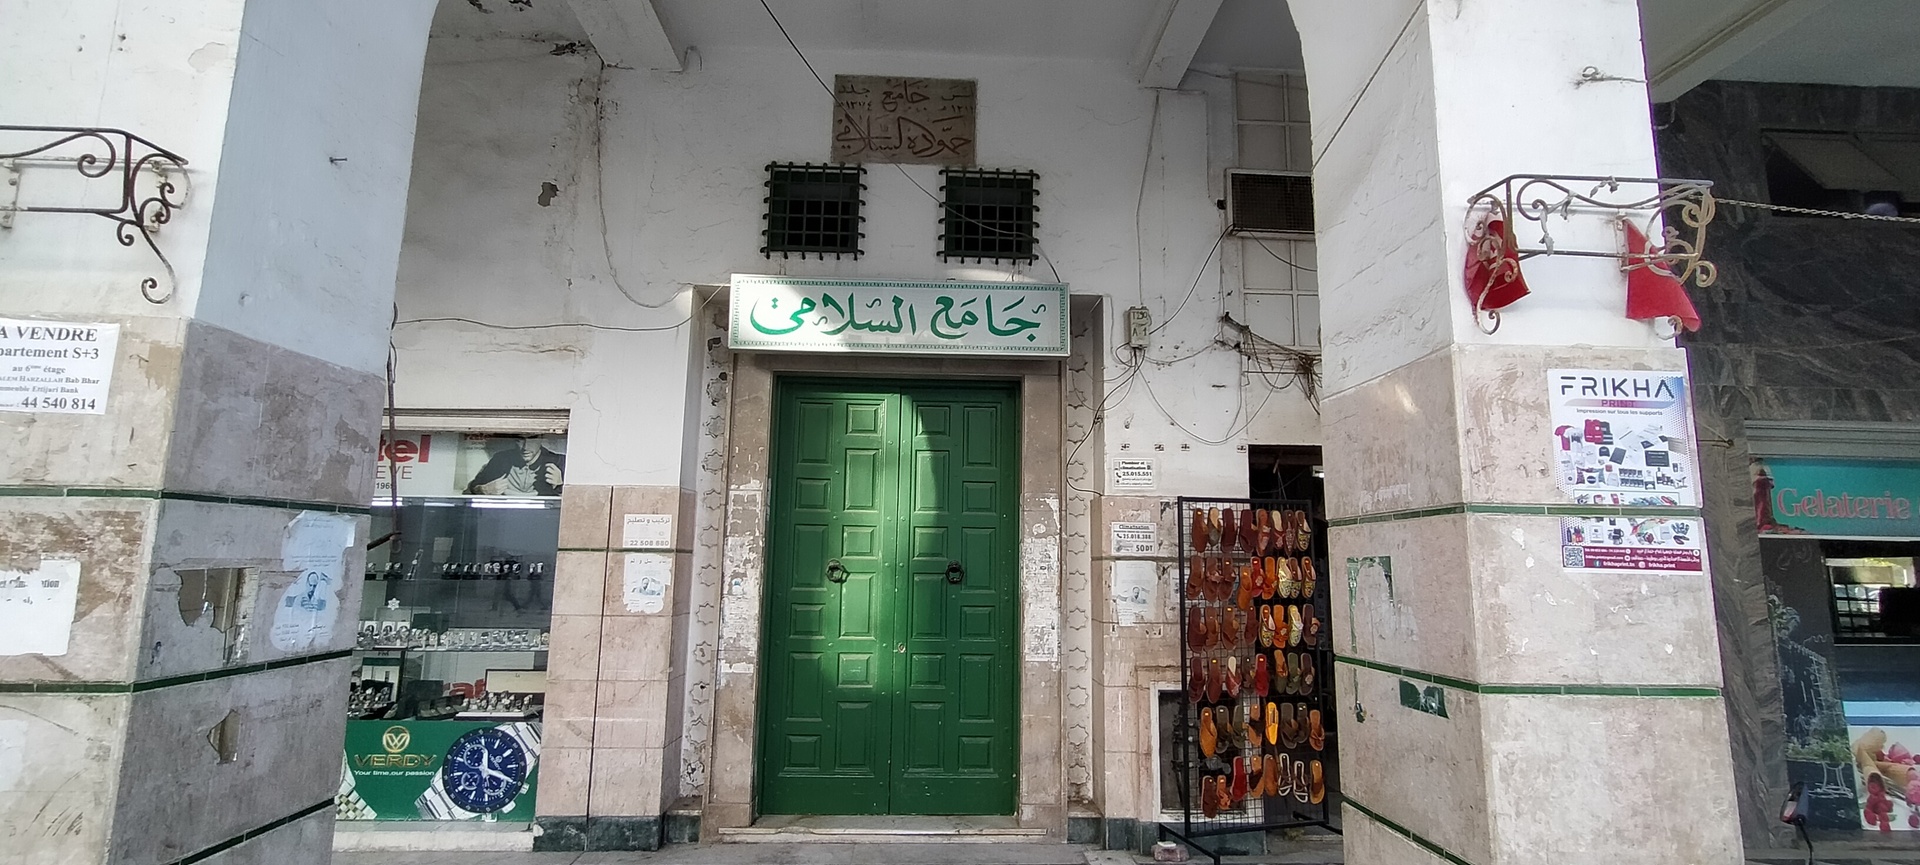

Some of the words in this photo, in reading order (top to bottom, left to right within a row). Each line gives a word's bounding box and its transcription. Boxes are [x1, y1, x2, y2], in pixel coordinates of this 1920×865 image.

[930, 294, 1047, 342] جامع
[0, 326, 8, 339] A
[17, 326, 98, 342] VENDRE
[72, 347, 99, 360] S+3
[43, 365, 66, 375] étage
[1560, 376, 1674, 399] FRIKHA
[21, 396, 38, 408] 44
[42, 397, 67, 409] 540
[71, 398, 96, 410] 814
[1601, 399, 1636, 408] PRINT
[1777, 487, 1911, 520] Gelaterie
[355, 754, 437, 768] VERDY
